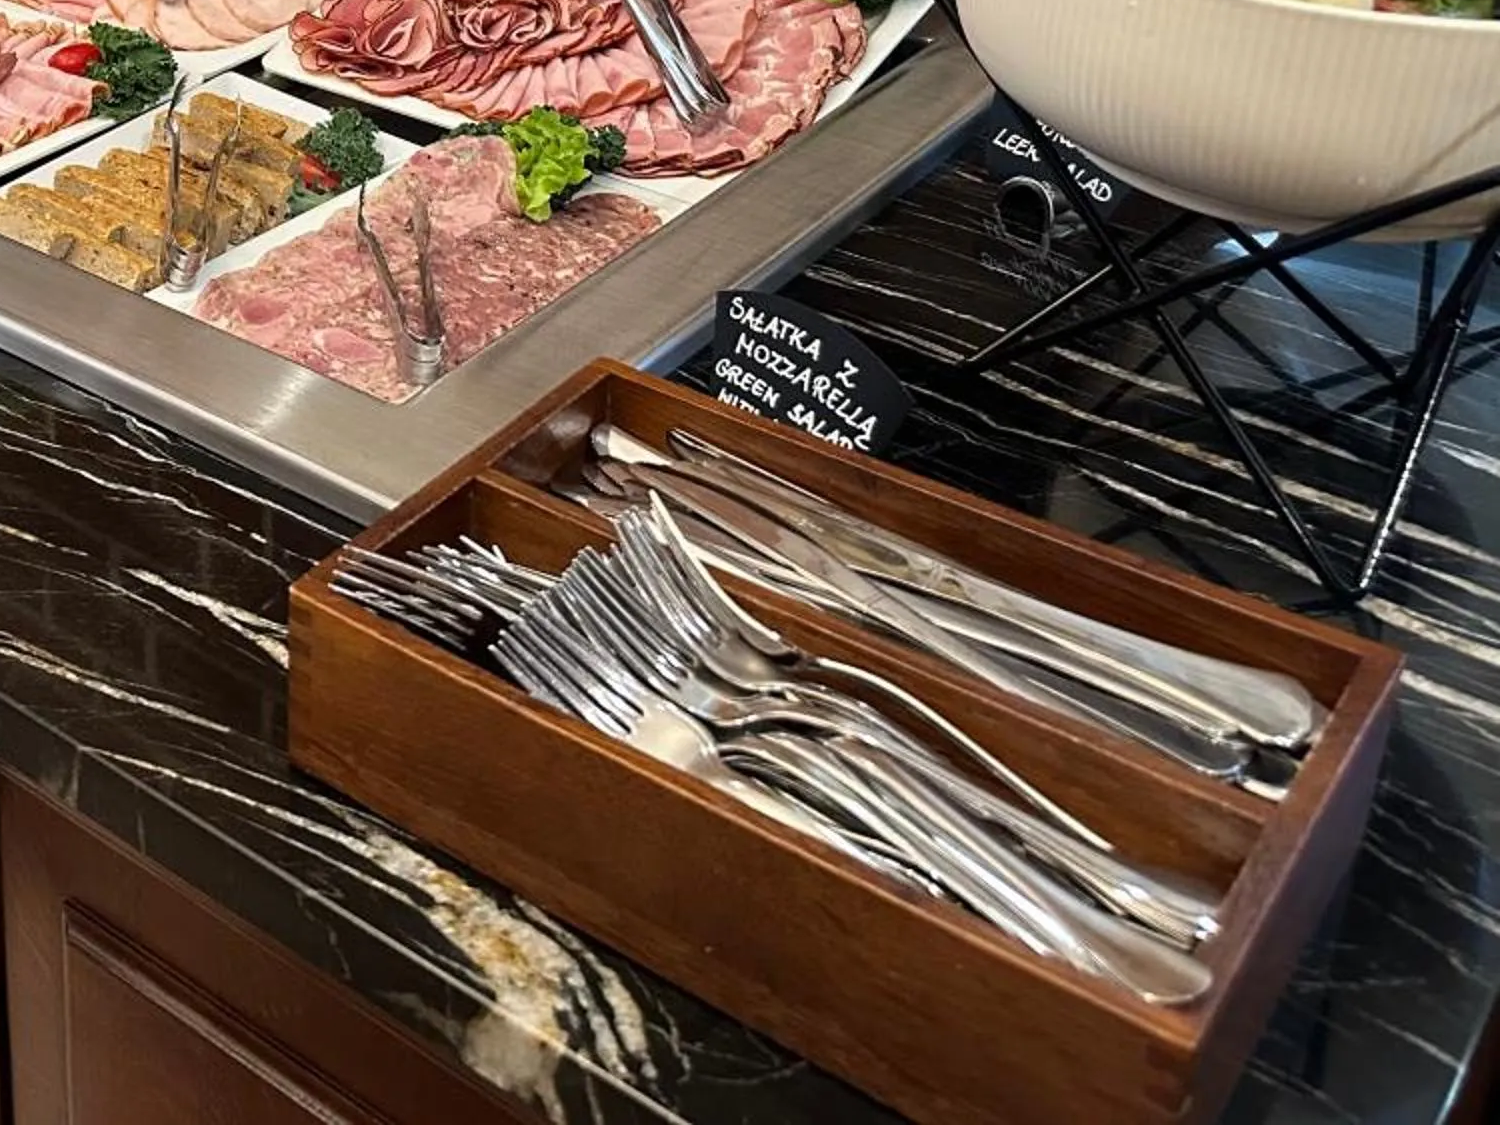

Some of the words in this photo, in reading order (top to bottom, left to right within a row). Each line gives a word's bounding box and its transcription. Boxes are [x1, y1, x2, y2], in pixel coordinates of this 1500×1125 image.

[1064, 161, 1114, 203] ALAD
[728, 296, 822, 362] SAŁATKA
[715, 358, 781, 409] GREEN
